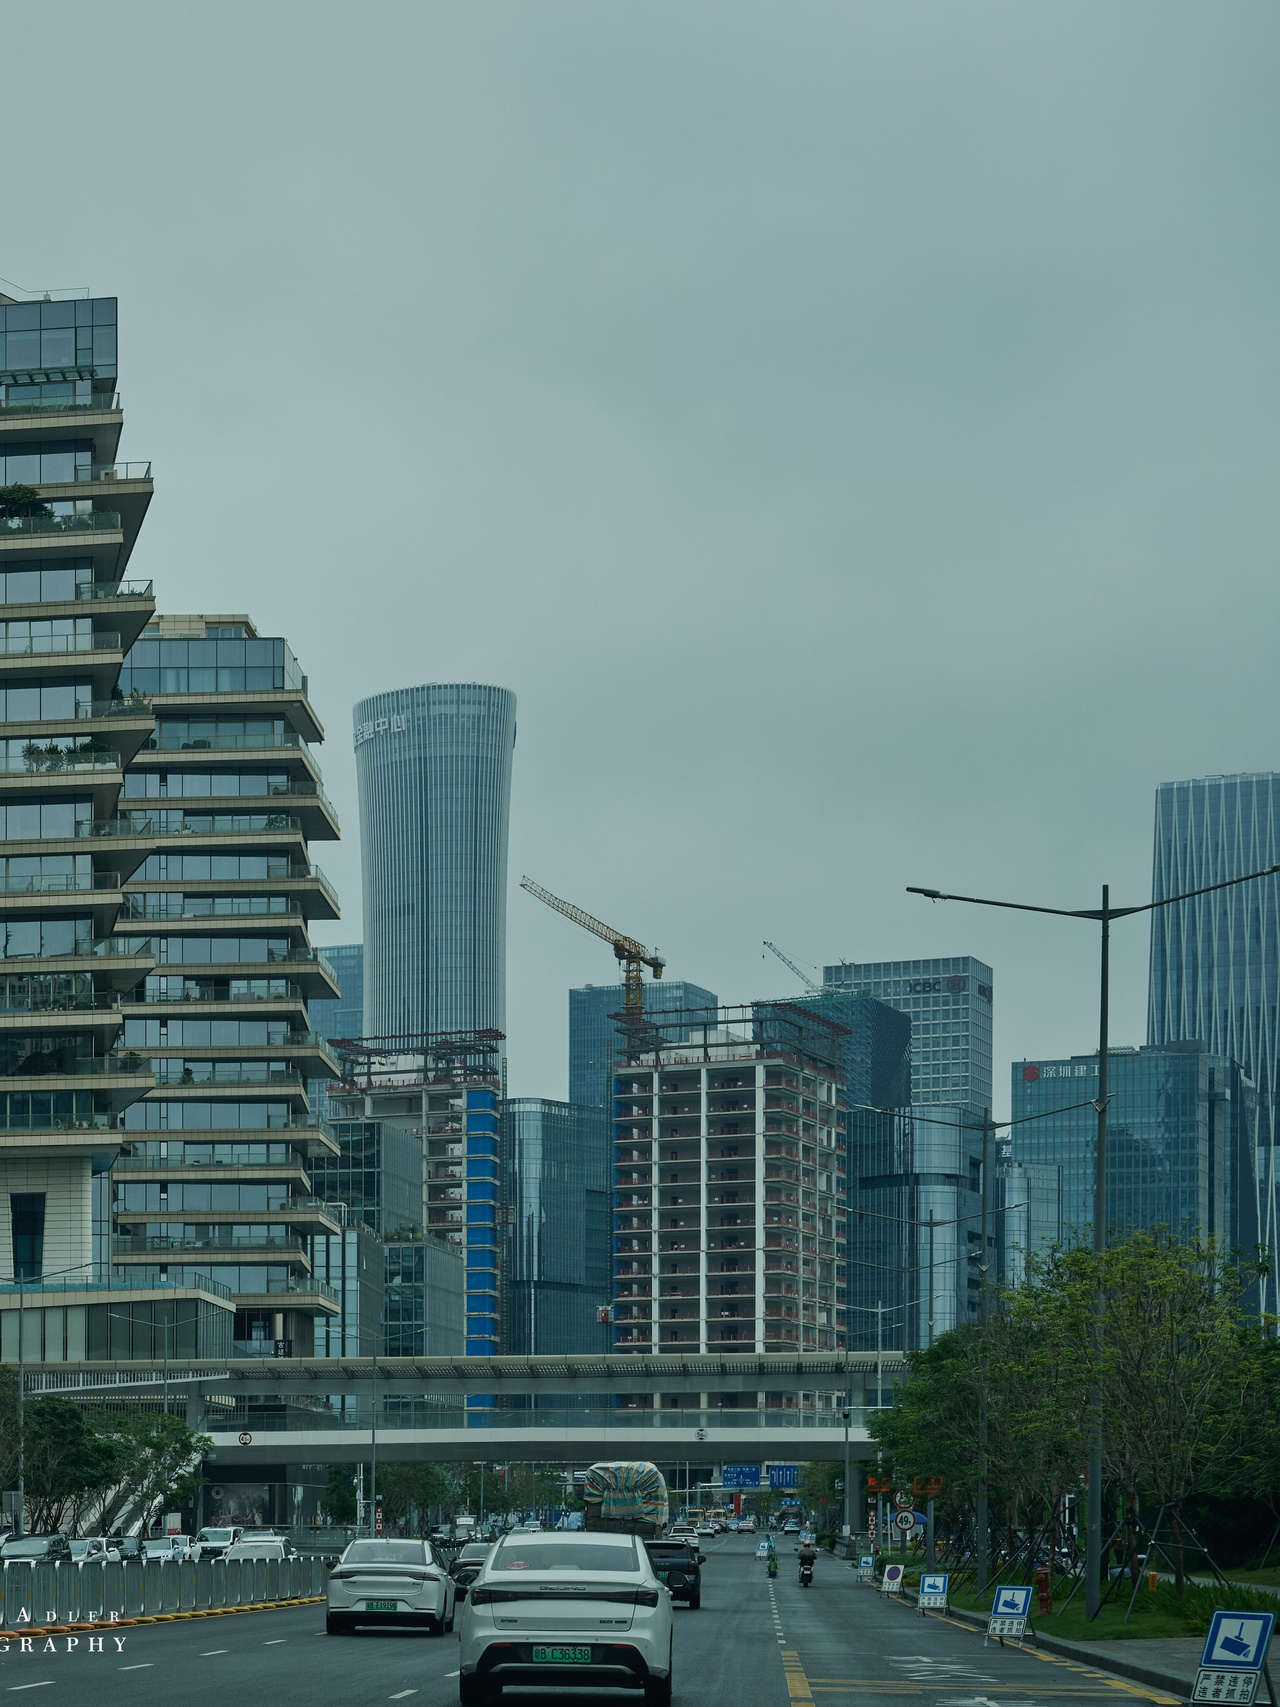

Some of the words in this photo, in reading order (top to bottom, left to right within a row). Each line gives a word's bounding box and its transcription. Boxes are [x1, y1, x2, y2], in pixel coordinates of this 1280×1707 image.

[909, 981, 941, 994] ICBC
[1043, 1065, 1100, 1078] 深圳建工
[991, 1619, 1023, 1627] 严禁违停
[1200, 1673, 1254, 1688] 严禁违停
[1196, 1686, 1250, 1700] 违者抓拍
